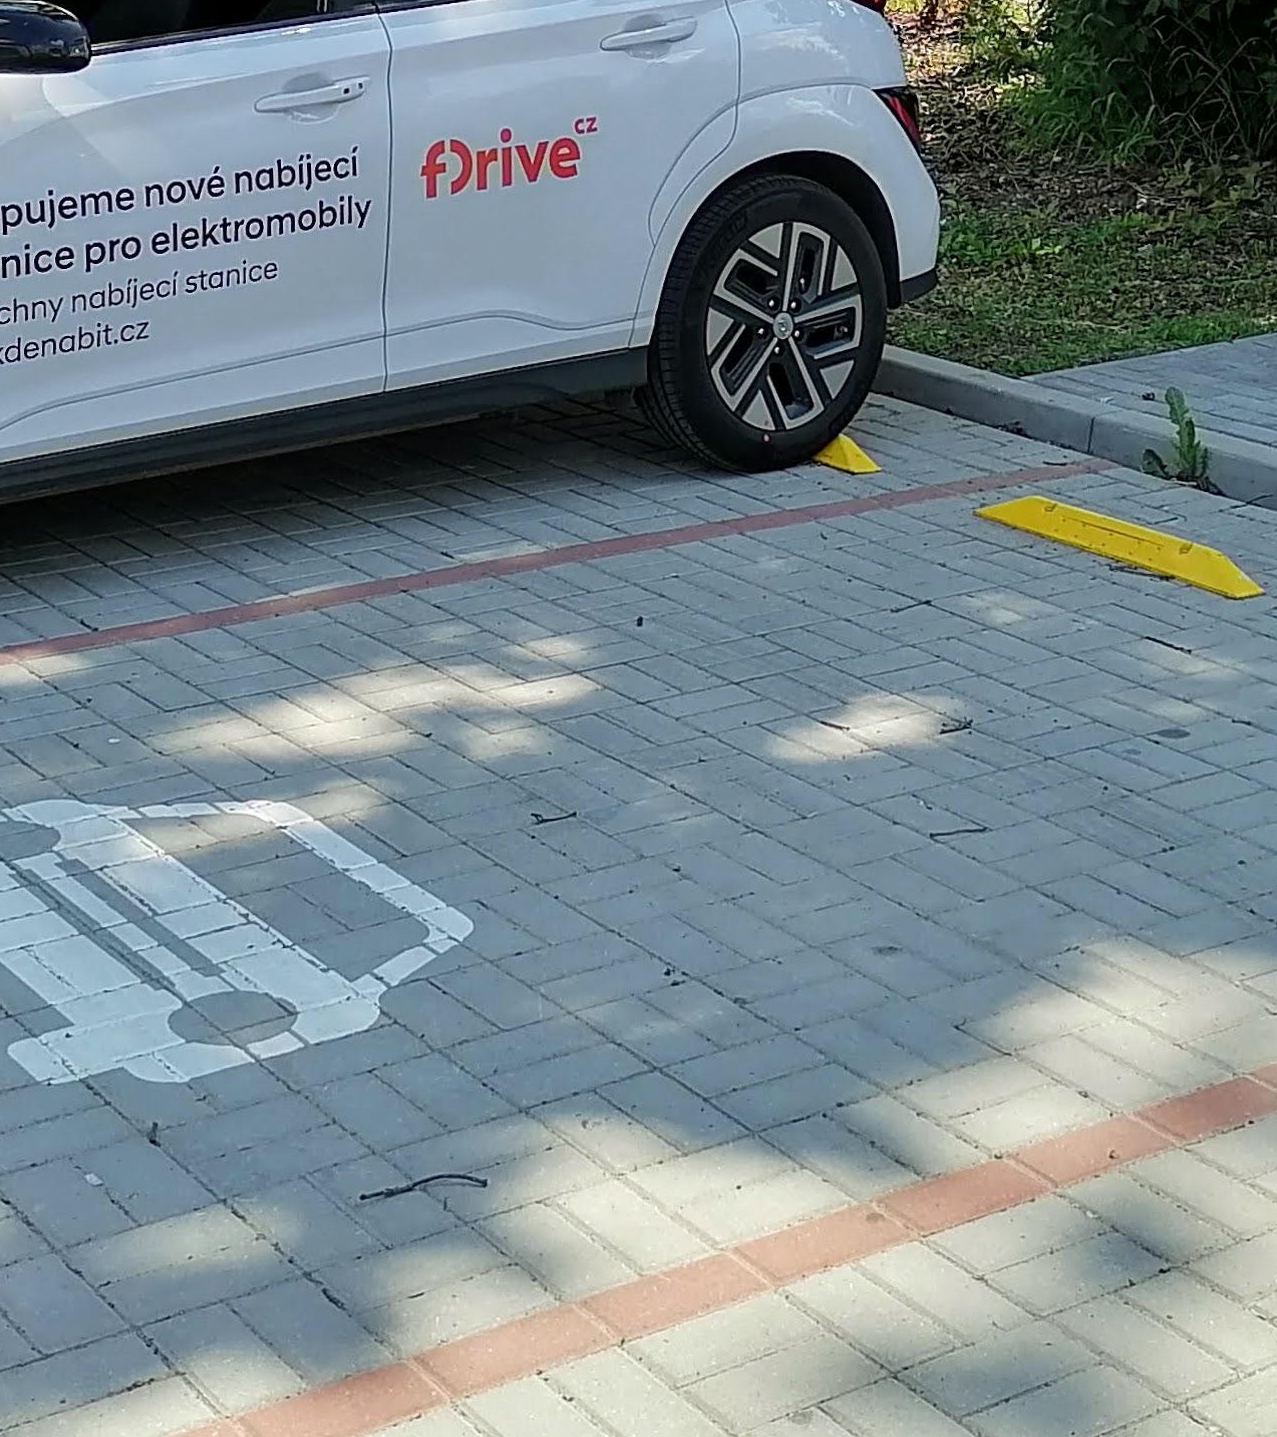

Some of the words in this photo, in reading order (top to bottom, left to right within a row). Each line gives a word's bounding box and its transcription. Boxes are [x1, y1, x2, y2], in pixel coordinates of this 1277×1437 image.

[145, 166, 225, 207] nové
[235, 146, 359, 194] nabíjecí
[85, 236, 142, 272] pro
[151, 195, 372, 254] elektromobily
[72, 271, 179, 312] nabíjecí
[185, 259, 278, 294] stanice
